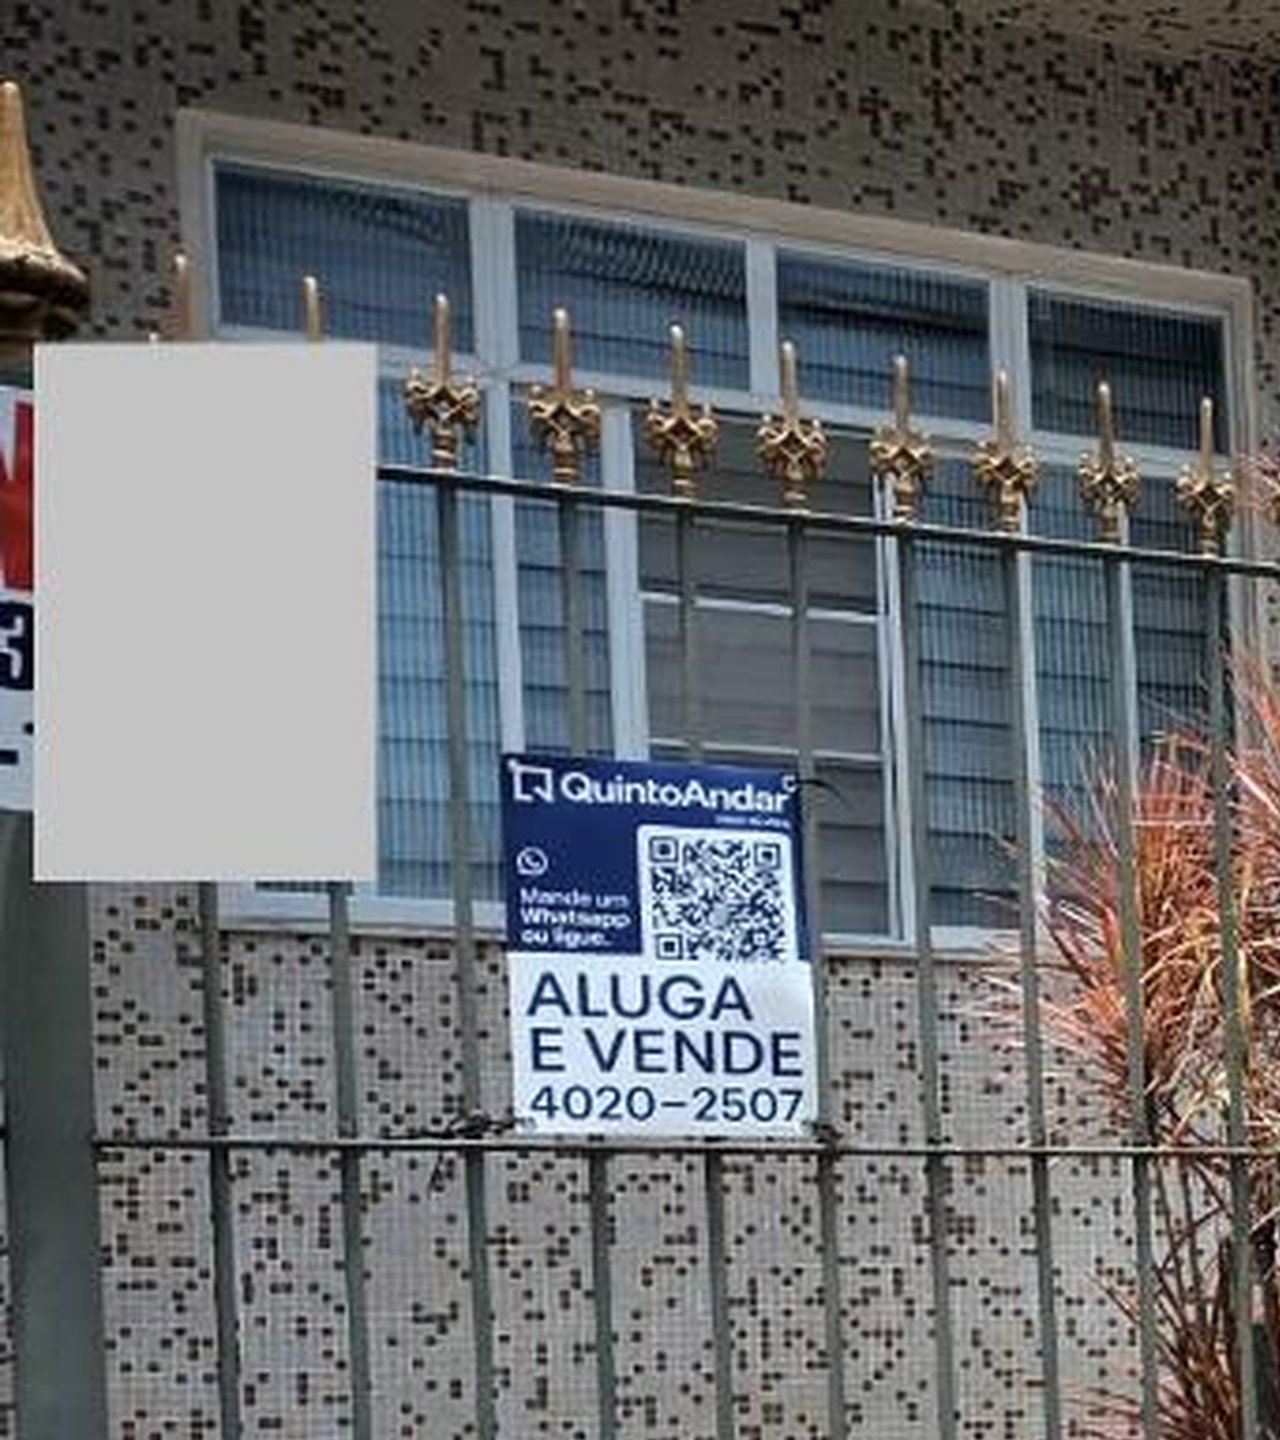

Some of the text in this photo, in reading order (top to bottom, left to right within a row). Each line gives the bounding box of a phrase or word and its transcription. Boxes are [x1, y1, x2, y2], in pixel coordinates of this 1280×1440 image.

[560, 771, 789, 813] QuintoAndar
[519, 886, 630, 909] Mande um
[519, 907, 631, 929] Whatsapp
[521, 928, 549, 944] ou
[526, 972, 753, 1021] ALUGA
[530, 1027, 804, 1078] E VENDE
[530, 1085, 805, 1123] 4020-2507
